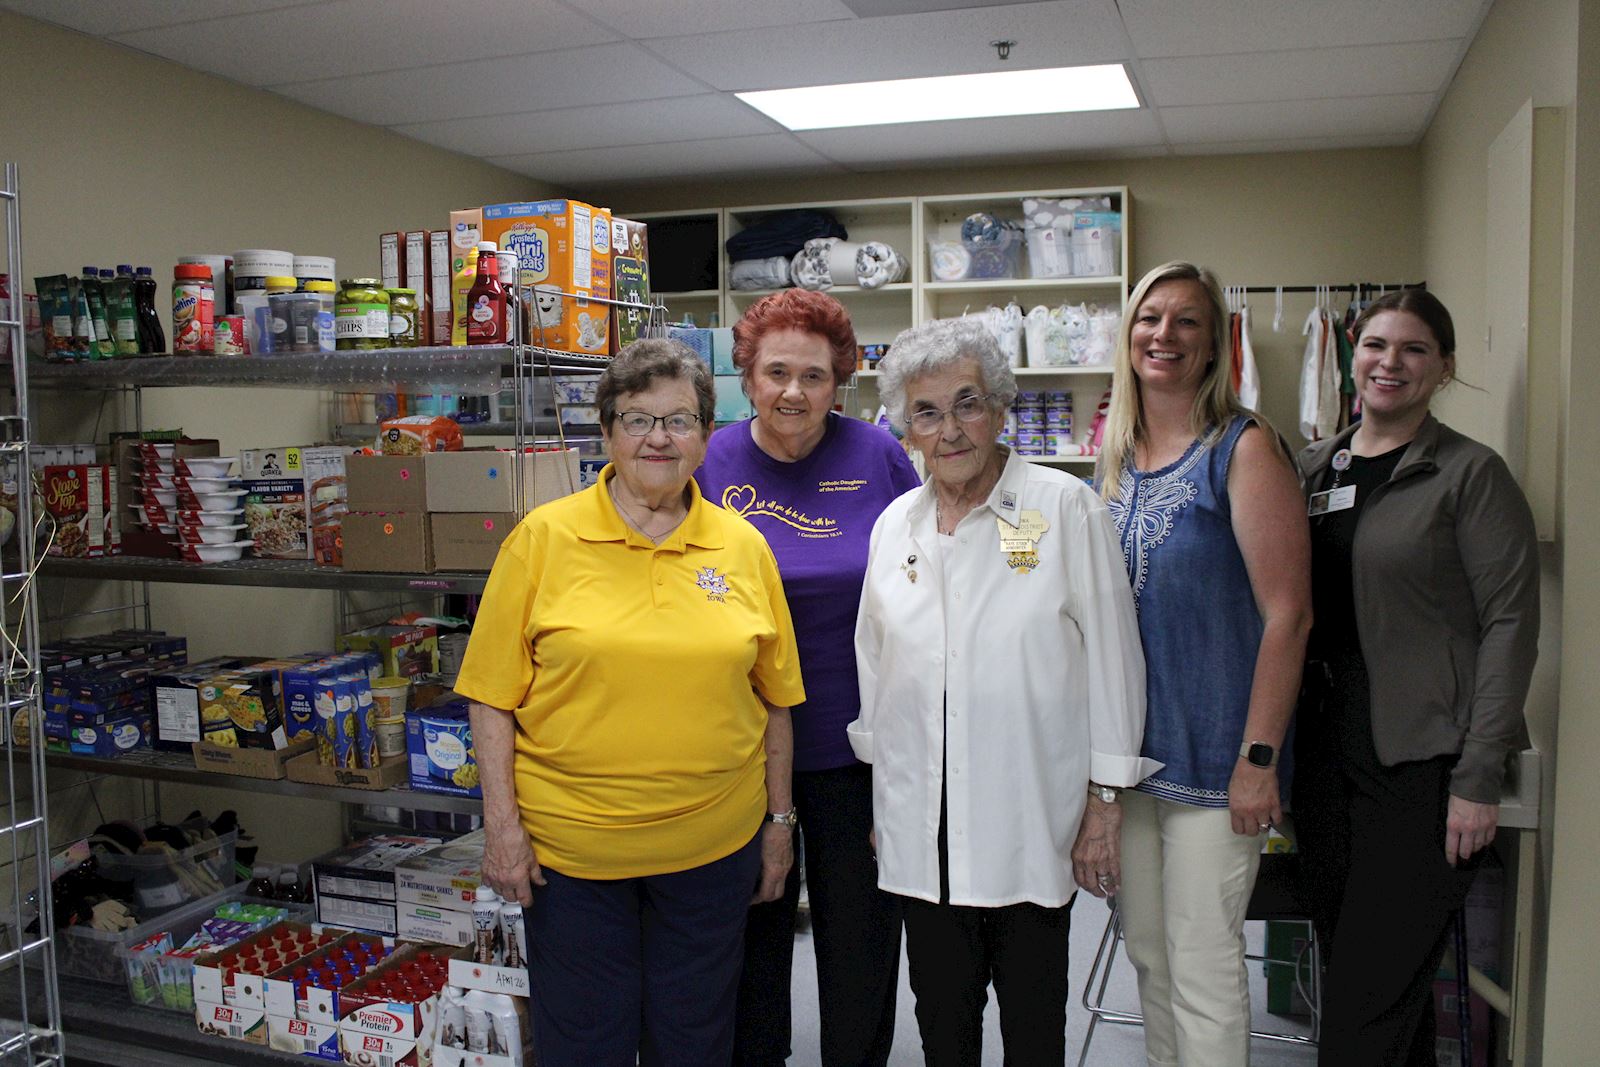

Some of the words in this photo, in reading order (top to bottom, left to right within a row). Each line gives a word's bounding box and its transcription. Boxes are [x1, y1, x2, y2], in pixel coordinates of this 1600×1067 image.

[511, 233, 536, 243] Frosted
[506, 241, 542, 258] Mini
[518, 254, 544, 272] heats
[337, 322, 363, 334] CHIPS
[288, 453, 298, 465] 52
[48, 477, 80, 504] Stove
[59, 494, 76, 511] Top
[756, 500, 766, 509] Let
[767, 500, 777, 508] all
[811, 517, 824, 526] with
[825, 517, 837, 527] love
[707, 595, 726, 604] IOWA
[434, 749, 461, 761] Original
[407, 882, 435, 892] NUTRITIONAL
[436, 886, 453, 895] SHAKES
[359, 1011, 392, 1025] Premier
[292, 1021, 306, 1031] 30g
[361, 1020, 390, 1031] Protein
[366, 1038, 381, 1048] 30g
